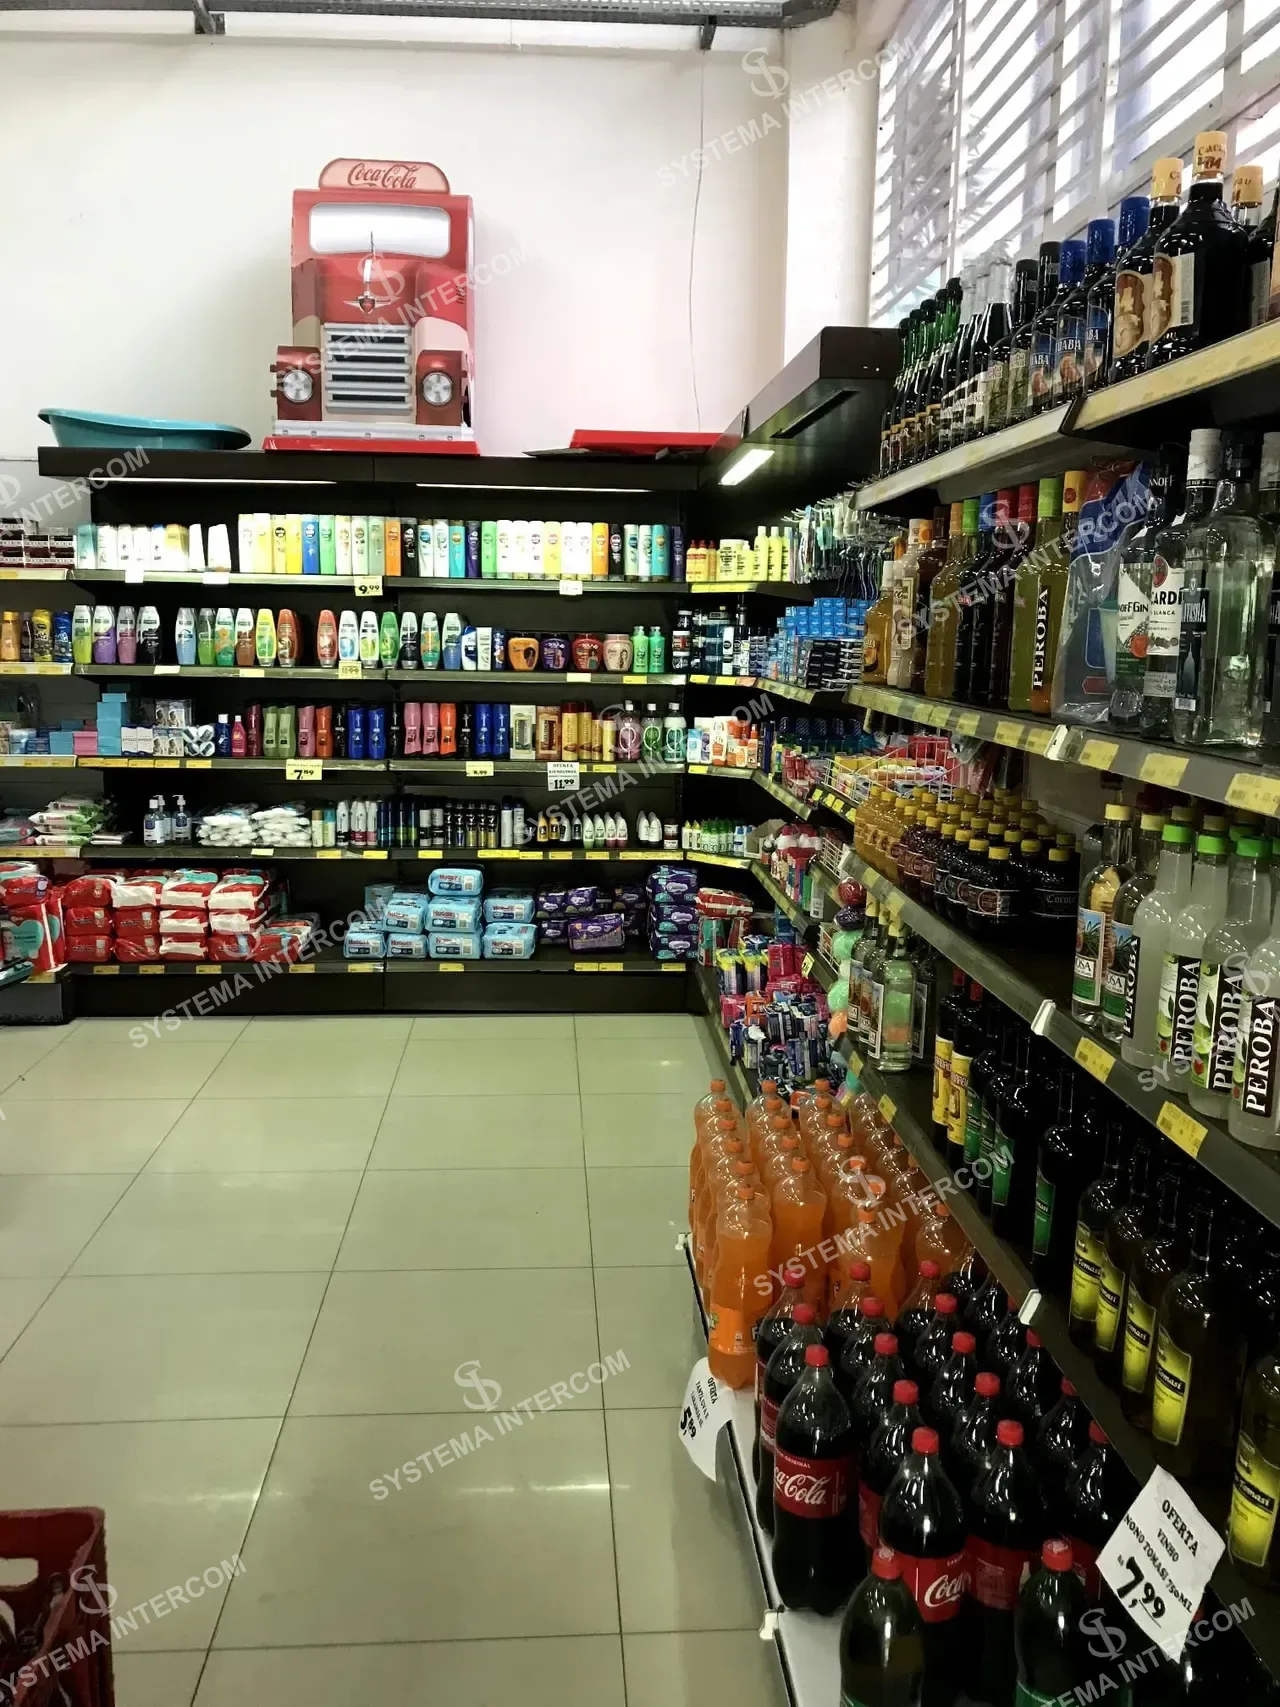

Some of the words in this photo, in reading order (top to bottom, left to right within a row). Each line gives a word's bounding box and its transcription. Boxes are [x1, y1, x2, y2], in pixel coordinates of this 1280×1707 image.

[348, 162, 421, 190] Coca-Cola
[358, 584, 380, 595] 9,99
[1033, 589, 1048, 688] PEROBA
[1123, 939, 1139, 1033] PEROBA
[1173, 960, 1201, 1063] PEROBA
[1213, 974, 1245, 1089] PEROBA
[1246, 999, 1276, 1115] PEROBA
[1123, 1513, 1145, 1544] NONO
[1143, 1541, 1169, 1582] TOMASI
[1165, 1579, 1193, 1614] 750ML
[1156, 1527, 1180, 1563] VINHO
[1161, 1498, 1199, 1557] OFERTA
[1116, 1555, 1167, 1620] 7,99
